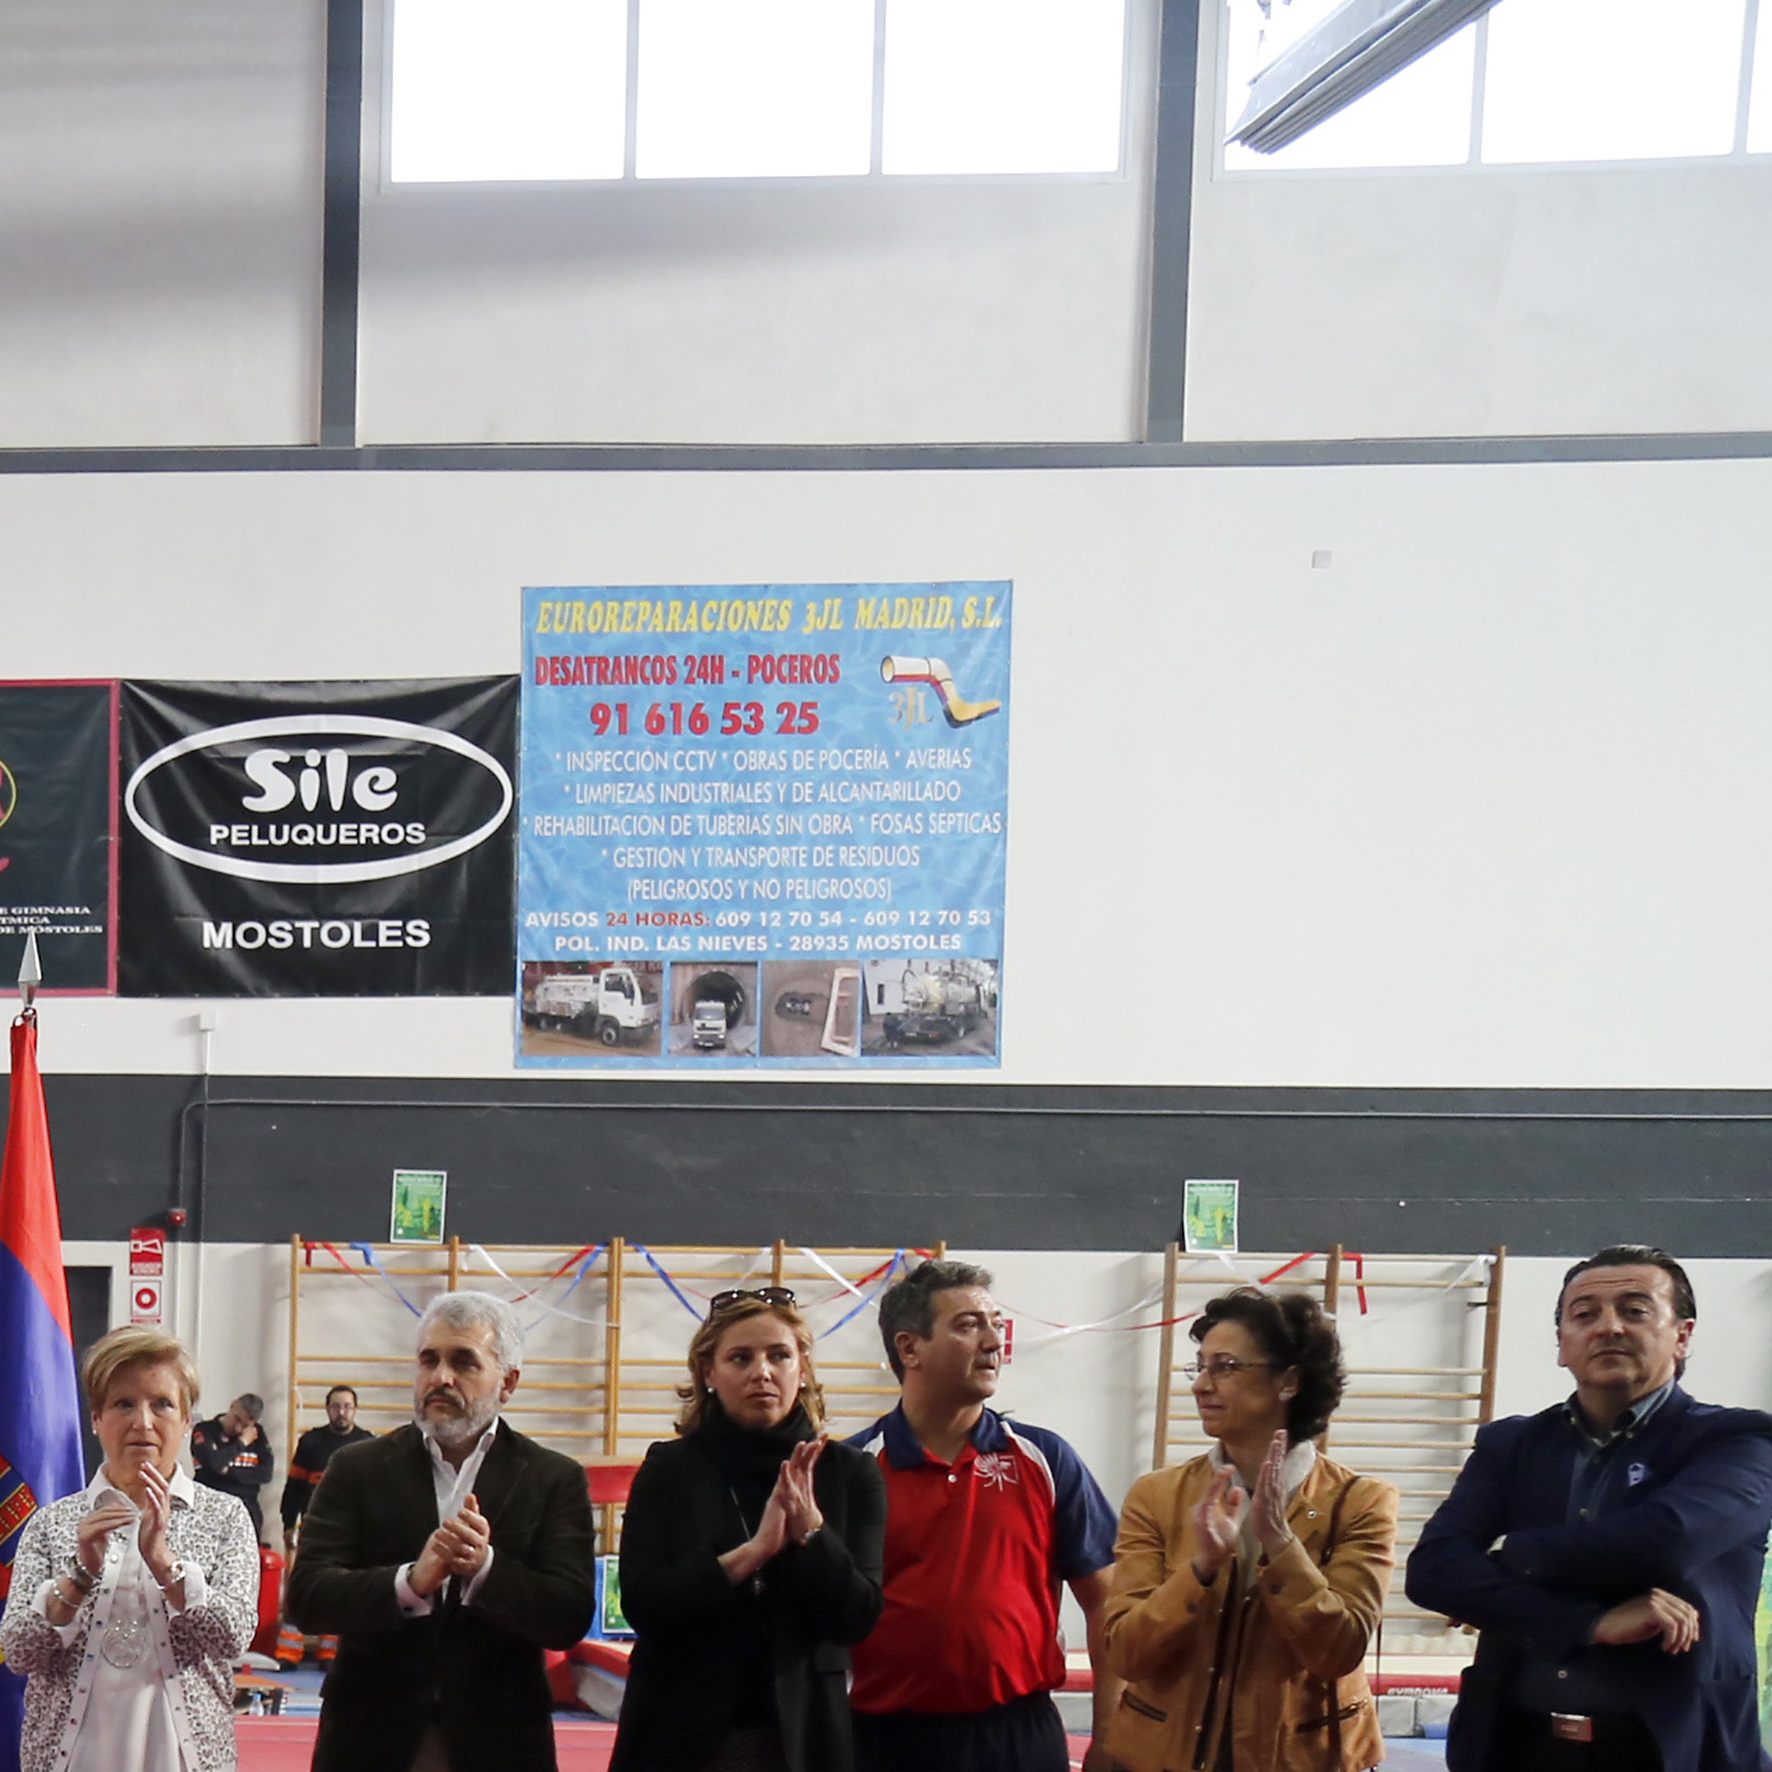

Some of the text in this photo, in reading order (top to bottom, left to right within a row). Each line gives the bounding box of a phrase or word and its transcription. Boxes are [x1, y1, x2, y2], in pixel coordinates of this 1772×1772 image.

[536, 596, 1003, 634] EUROREPARACIONES 3JL MADRID, S.L.
[535, 655, 677, 686] DESATRANCOS
[683, 655, 725, 684] 24H
[747, 654, 841, 684] POCEROS
[590, 702, 820, 735] 91 616 53 25
[567, 746, 668, 771] INSPECCIÓN
[673, 751, 717, 771] CCTV
[733, 750, 788, 771] OBRAS
[793, 750, 814, 770] DE
[820, 745, 889, 770] POCERÍA
[242, 748, 398, 812] Sile
[576, 781, 961, 804] LIMPIEZAS INDUSTRIALES Y DE ALCANTARILLADO
[209, 823, 426, 846] PELUQUEROS
[534, 811, 665, 836] REHABILITACIÓN
[671, 815, 692, 836] DE
[775, 814, 803, 835] SIN
[808, 814, 853, 835] OBRA
[871, 813, 923, 834] FOSAS
[929, 808, 1002, 834] SÉPTICAS
[691, 847, 702, 868] Y
[706, 846, 807, 868] TRANSPORTE
[813, 847, 834, 867] DE
[839, 845, 920, 866] RESIDUOS
[628, 878, 892, 904] (PELIGROSOS Y NO PELIGROSOS)
[11, 906, 91, 915] GIMNASIA
[525, 912, 599, 927] AVISOS
[606, 912, 629, 926] 24
[636, 912, 711, 926] HORAS:
[716, 911, 751, 927] 609
[760, 912, 782, 926] 12
[788, 912, 812, 926] 70
[818, 911, 842, 926] 54
[864, 911, 899, 926] 609
[909, 911, 930, 926] 12
[938, 911, 961, 926] 70
[968, 910, 991, 925] 53
[202, 919, 431, 949] MOSTOLES
[555, 937, 600, 951] POL.
[608, 937, 649, 951] IND.
[656, 936, 691, 951] LAS
[698, 936, 768, 951] NIEVES
[789, 936, 849, 951] 28935
[857, 935, 961, 951] MOSTOLES
